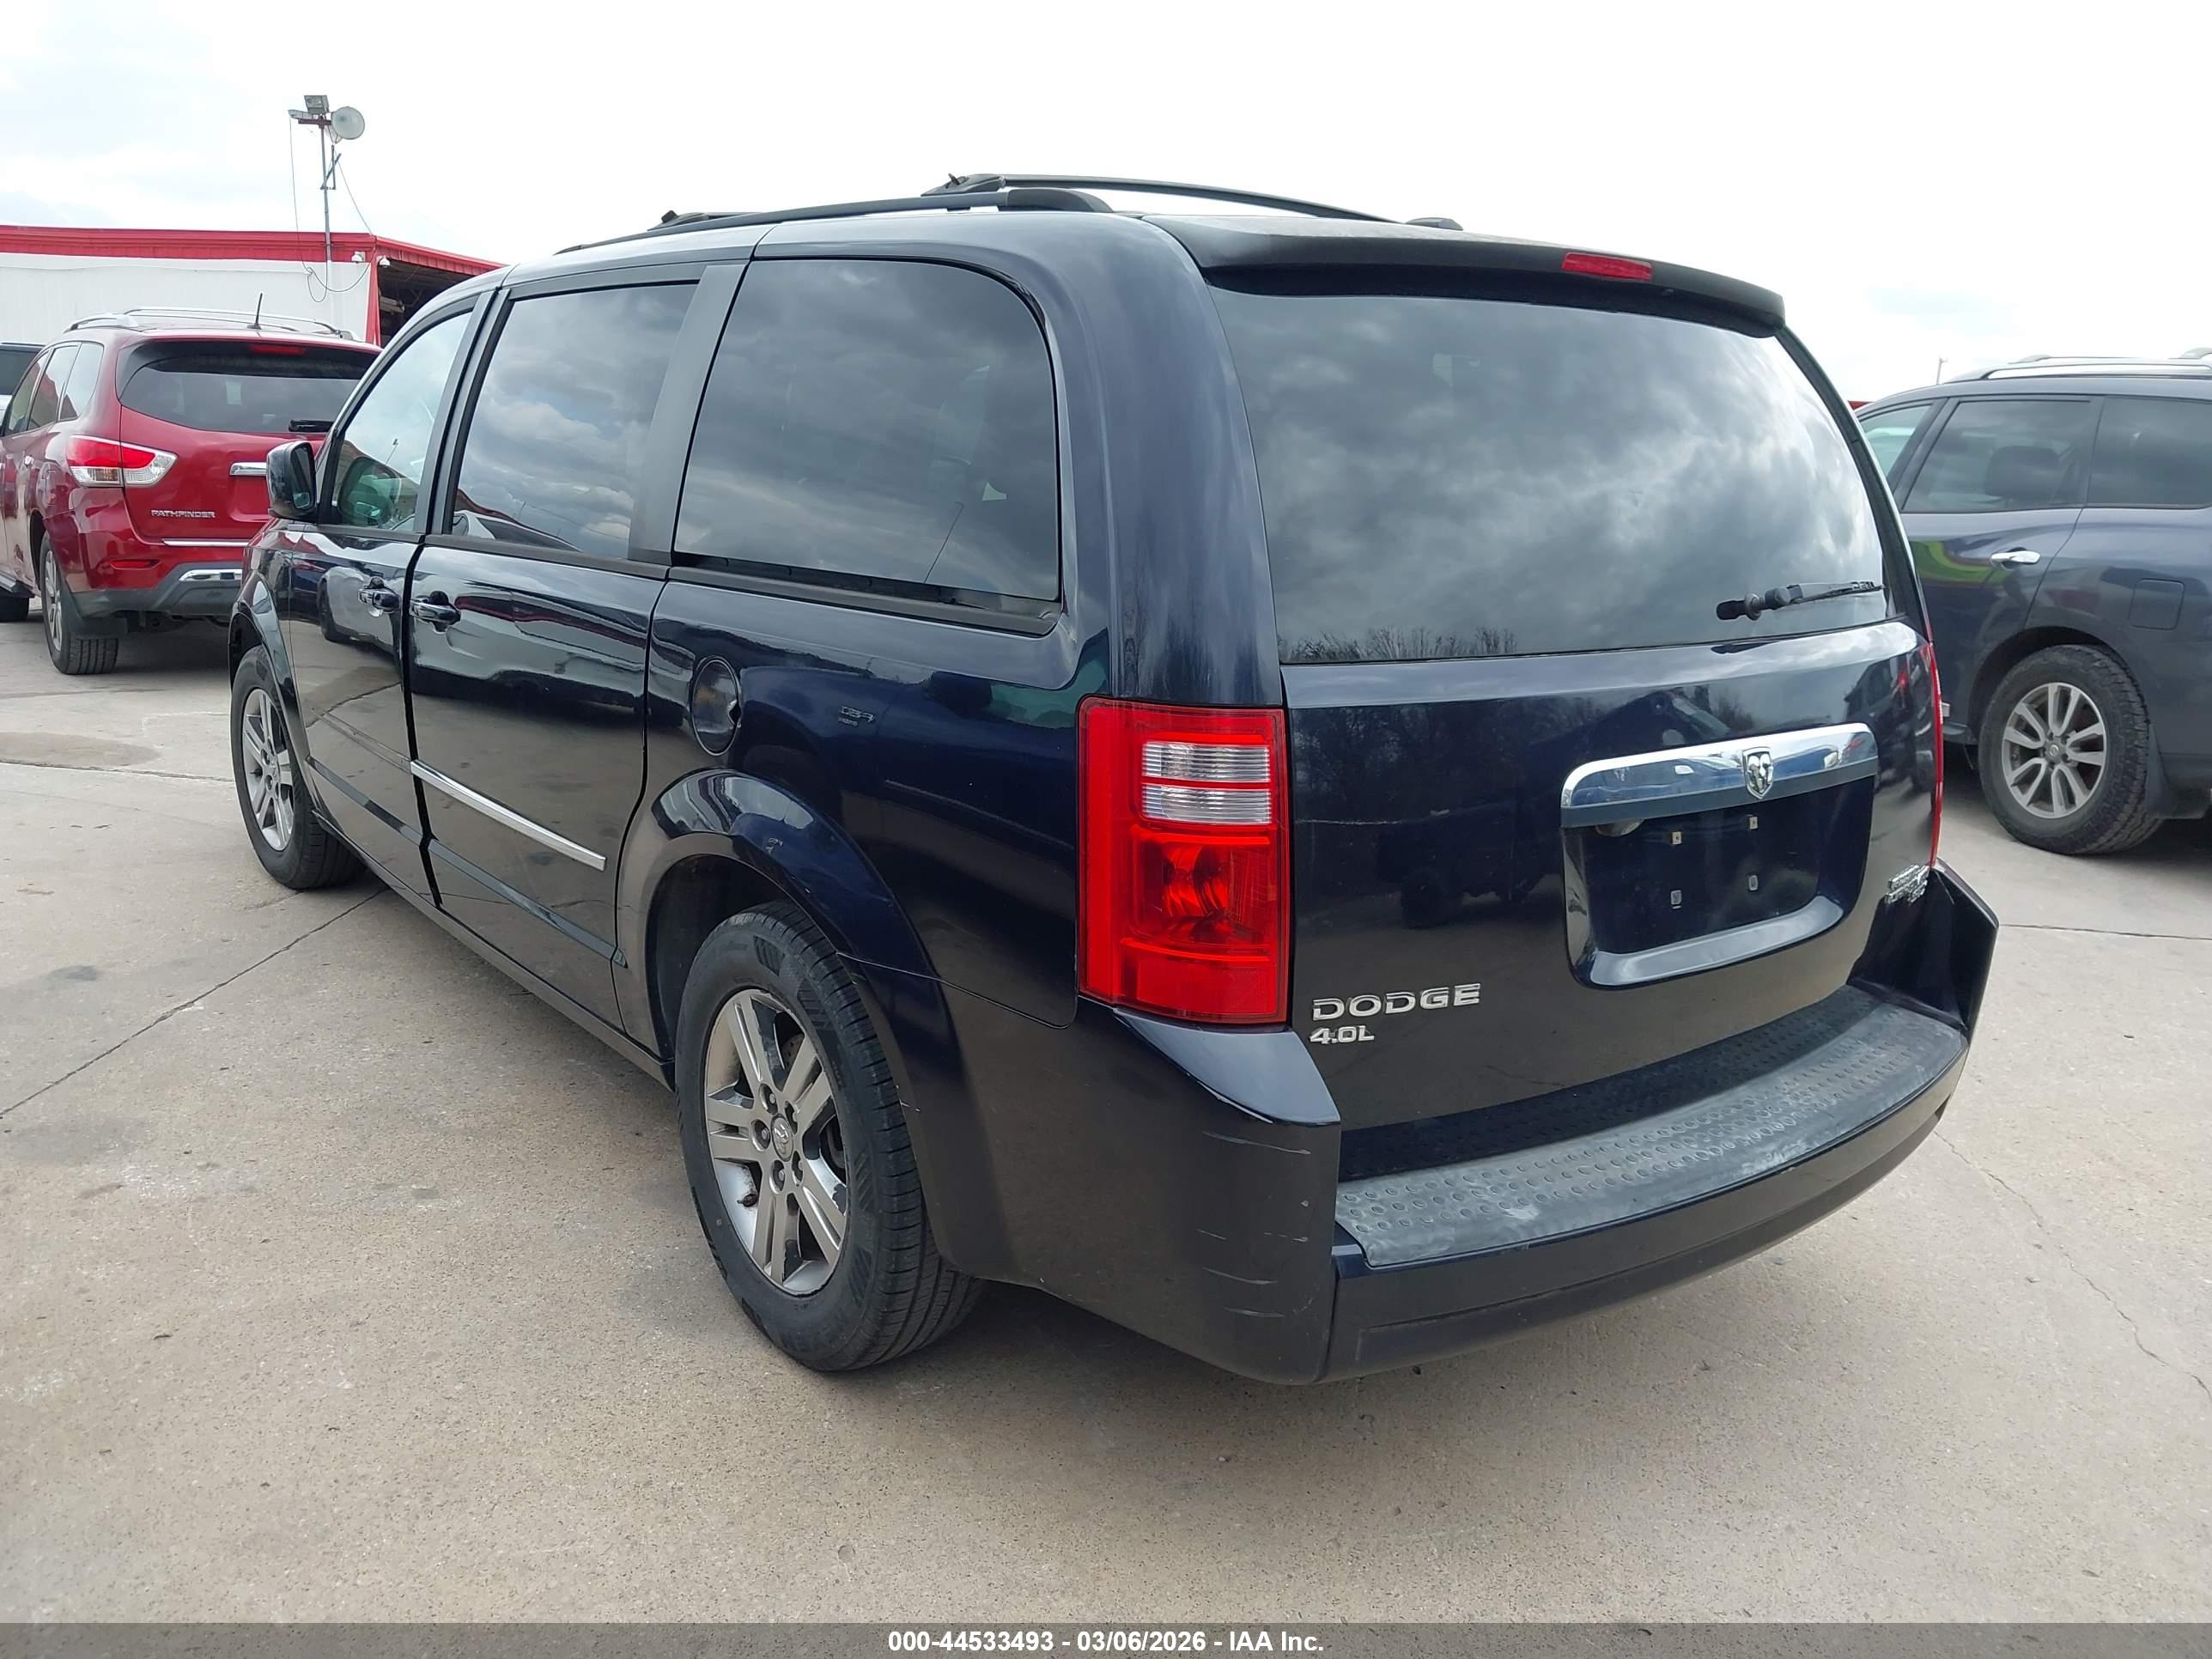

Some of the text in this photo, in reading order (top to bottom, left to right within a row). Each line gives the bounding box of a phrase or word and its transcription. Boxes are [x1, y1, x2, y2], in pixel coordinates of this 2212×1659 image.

[151, 509, 216, 518] PATHFINDER
[1312, 983, 1481, 1021] DODGE
[1310, 1025, 1375, 1044] 4.0L
